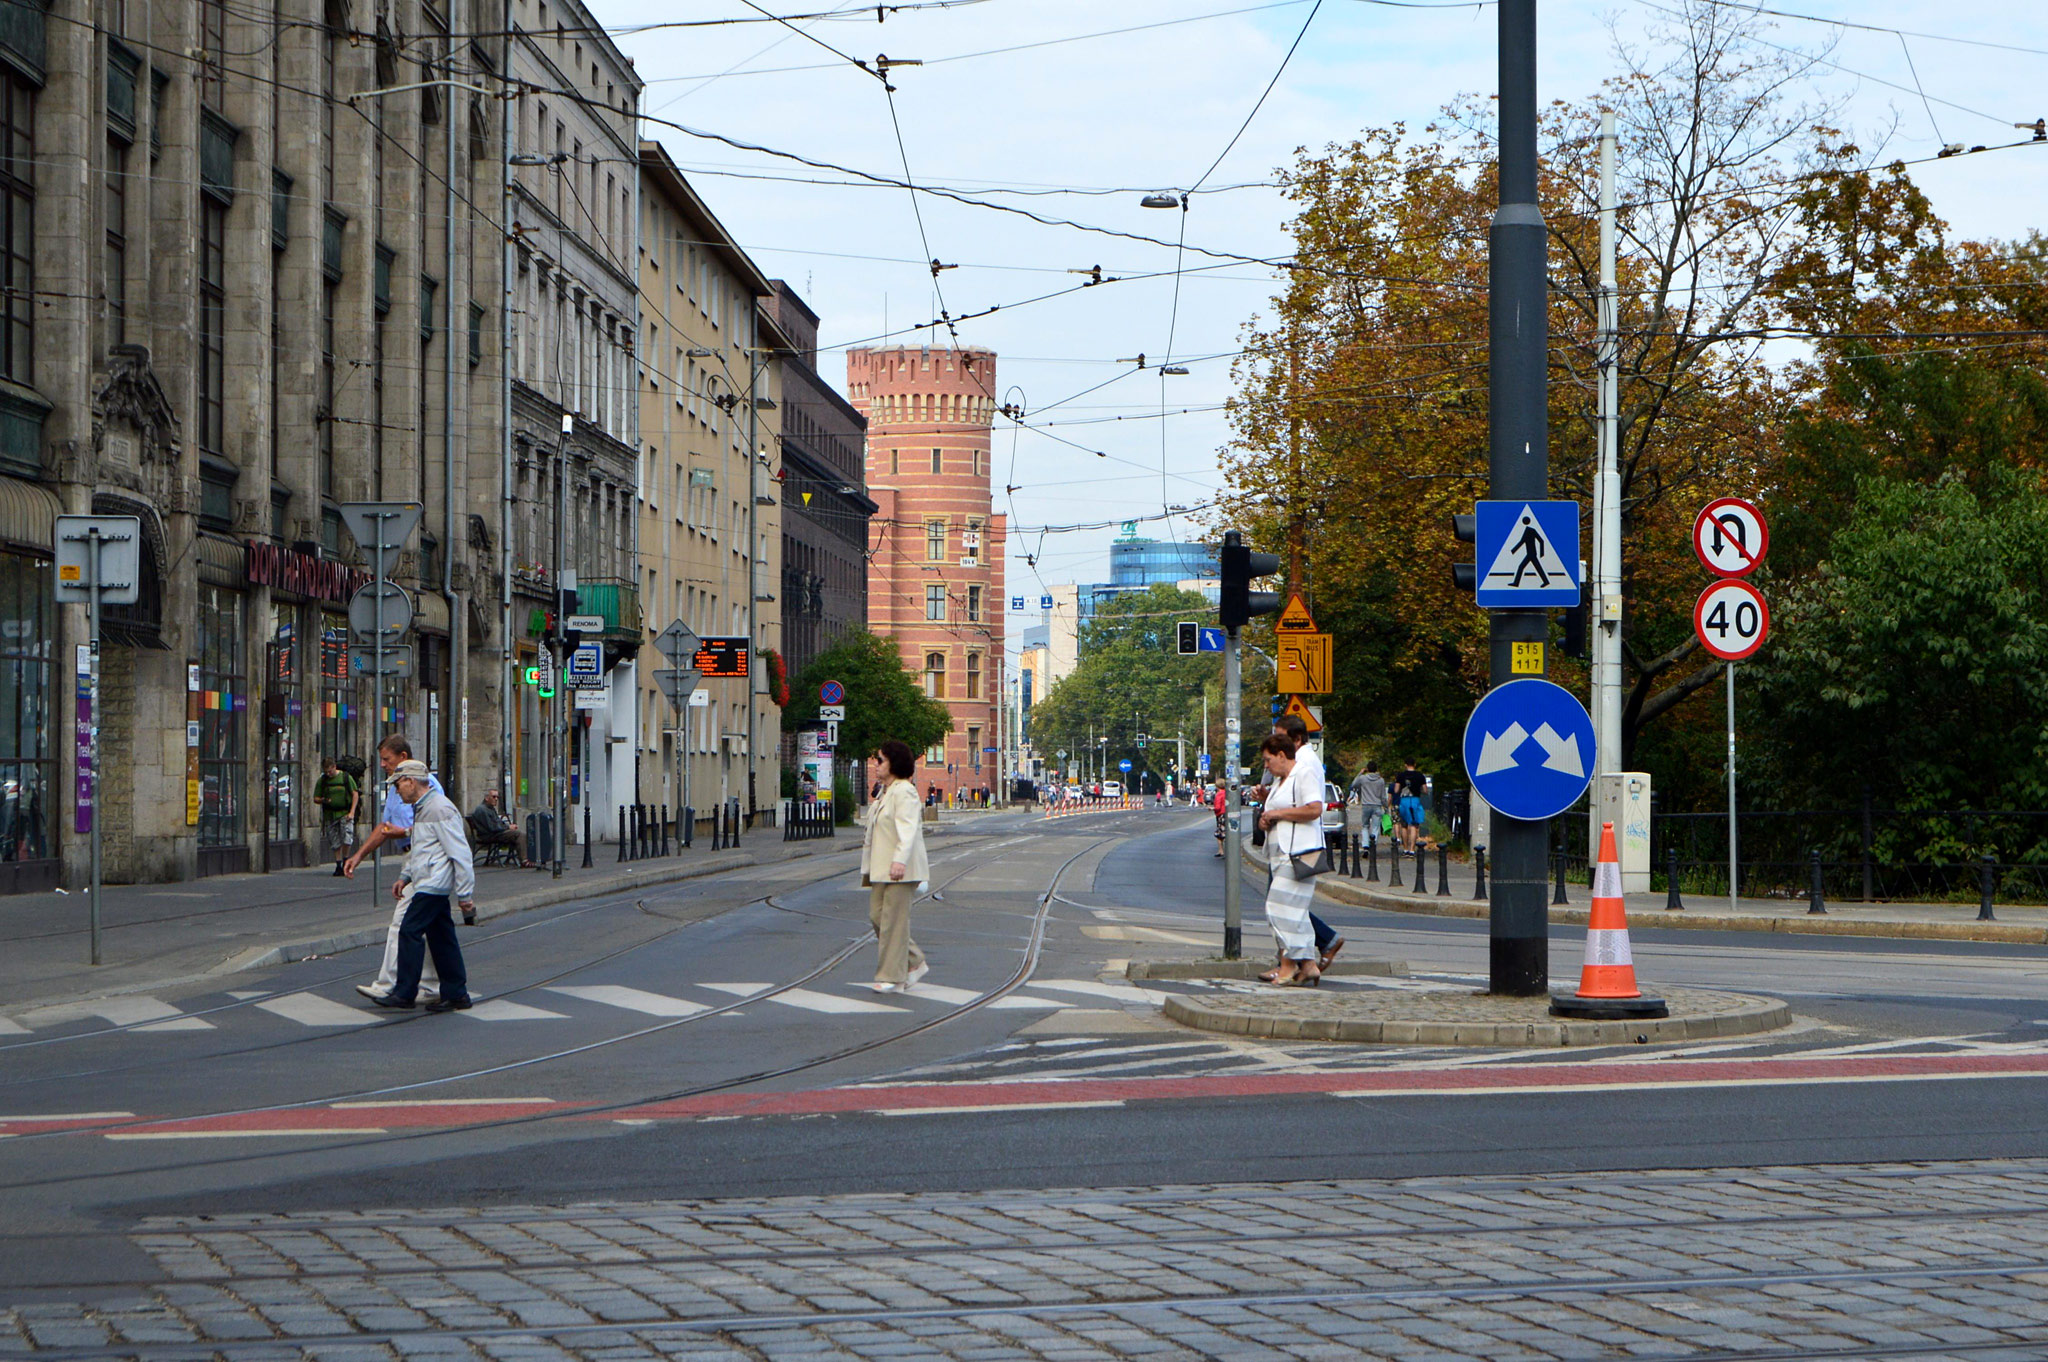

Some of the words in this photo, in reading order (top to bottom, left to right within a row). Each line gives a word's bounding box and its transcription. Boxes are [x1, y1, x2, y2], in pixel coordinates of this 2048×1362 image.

[249, 539, 279, 588] DOM
[284, 547, 349, 602] HANDLOWY
[1705, 600, 1758, 638] 40
[1517, 644, 1538, 655] 515
[1516, 659, 1539, 669] 117
